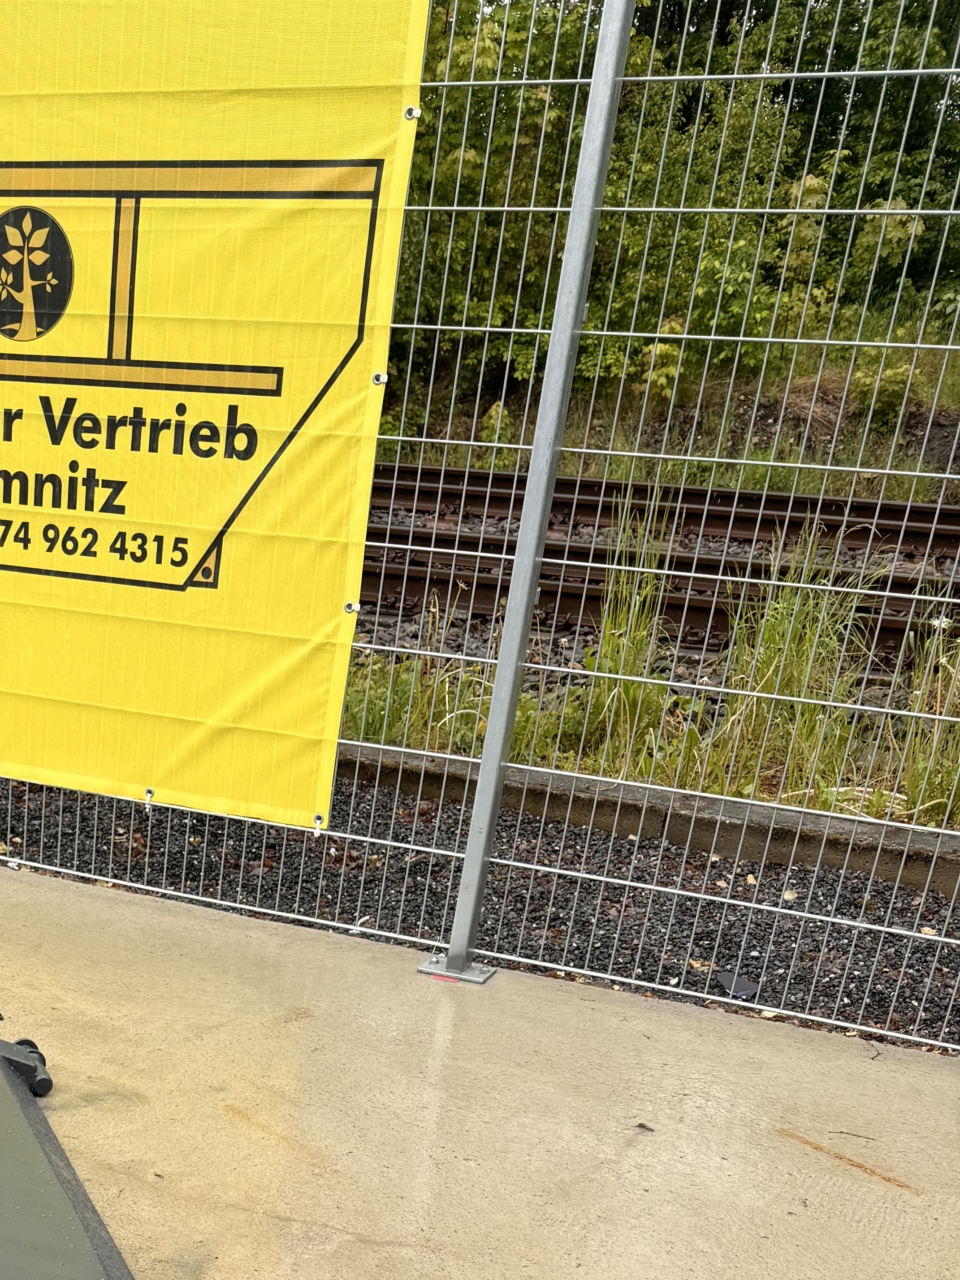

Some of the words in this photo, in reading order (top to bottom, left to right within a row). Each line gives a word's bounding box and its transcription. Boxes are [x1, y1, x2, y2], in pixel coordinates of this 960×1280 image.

[38, 396, 258, 461] Vertrieb
[42, 523, 99, 558] 962
[109, 531, 189, 568] 4315
